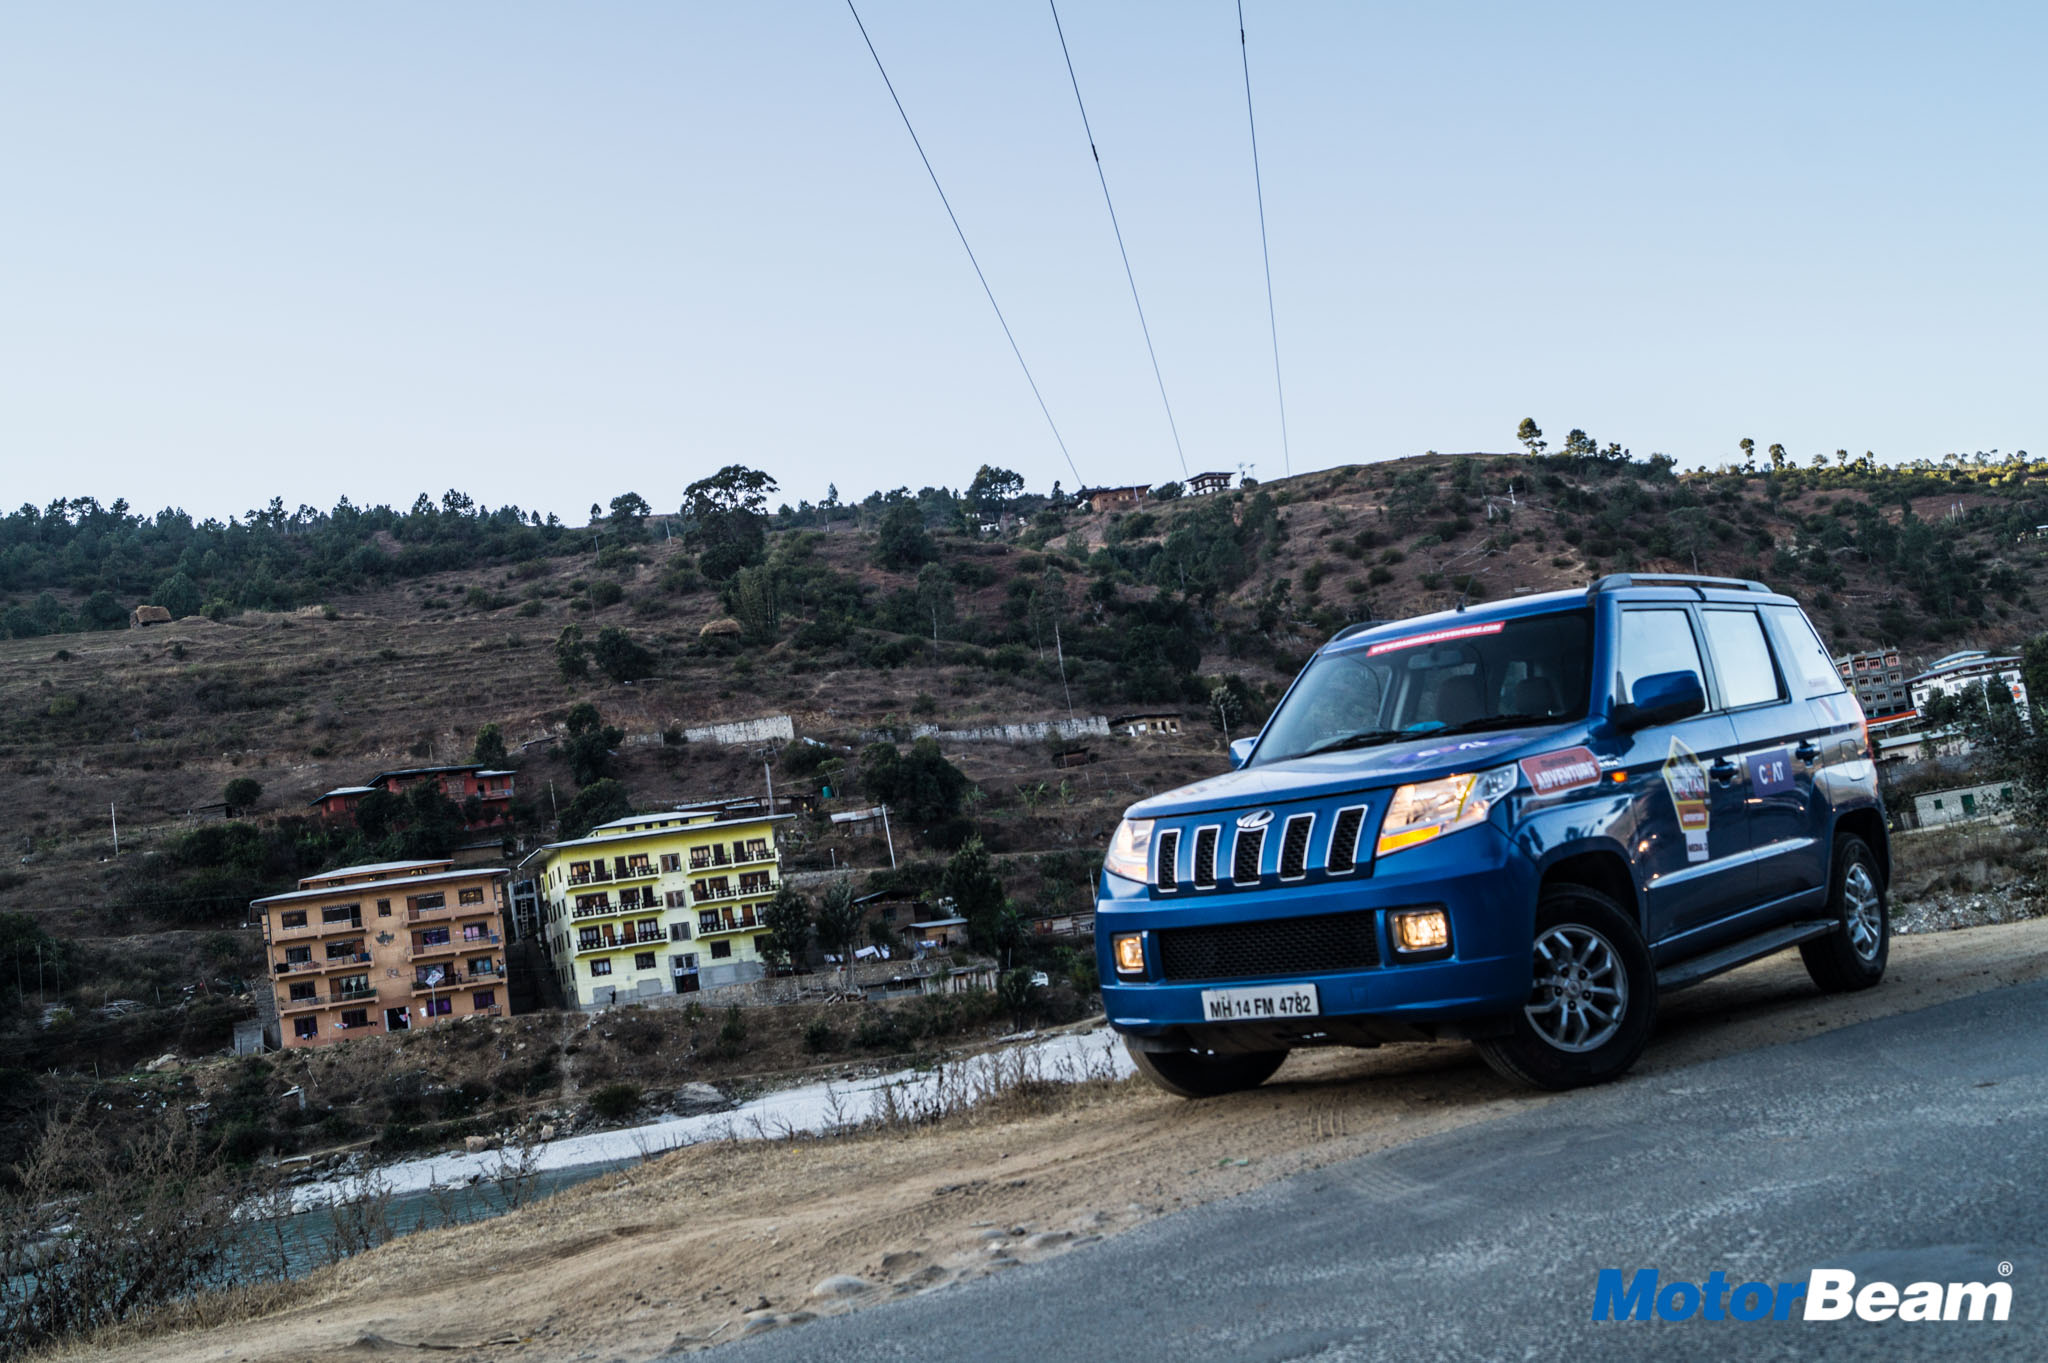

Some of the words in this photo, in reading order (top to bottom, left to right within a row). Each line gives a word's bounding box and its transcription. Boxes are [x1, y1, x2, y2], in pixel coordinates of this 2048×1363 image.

[1535, 761, 1598, 790] ADVENTURE
[1758, 761, 1785, 785] CEAT
[1210, 1000, 1233, 1018] MH
[1236, 1000, 1251, 1016] 14
[1254, 997, 1275, 1015] FM
[1279, 994, 1312, 1014] 4782
